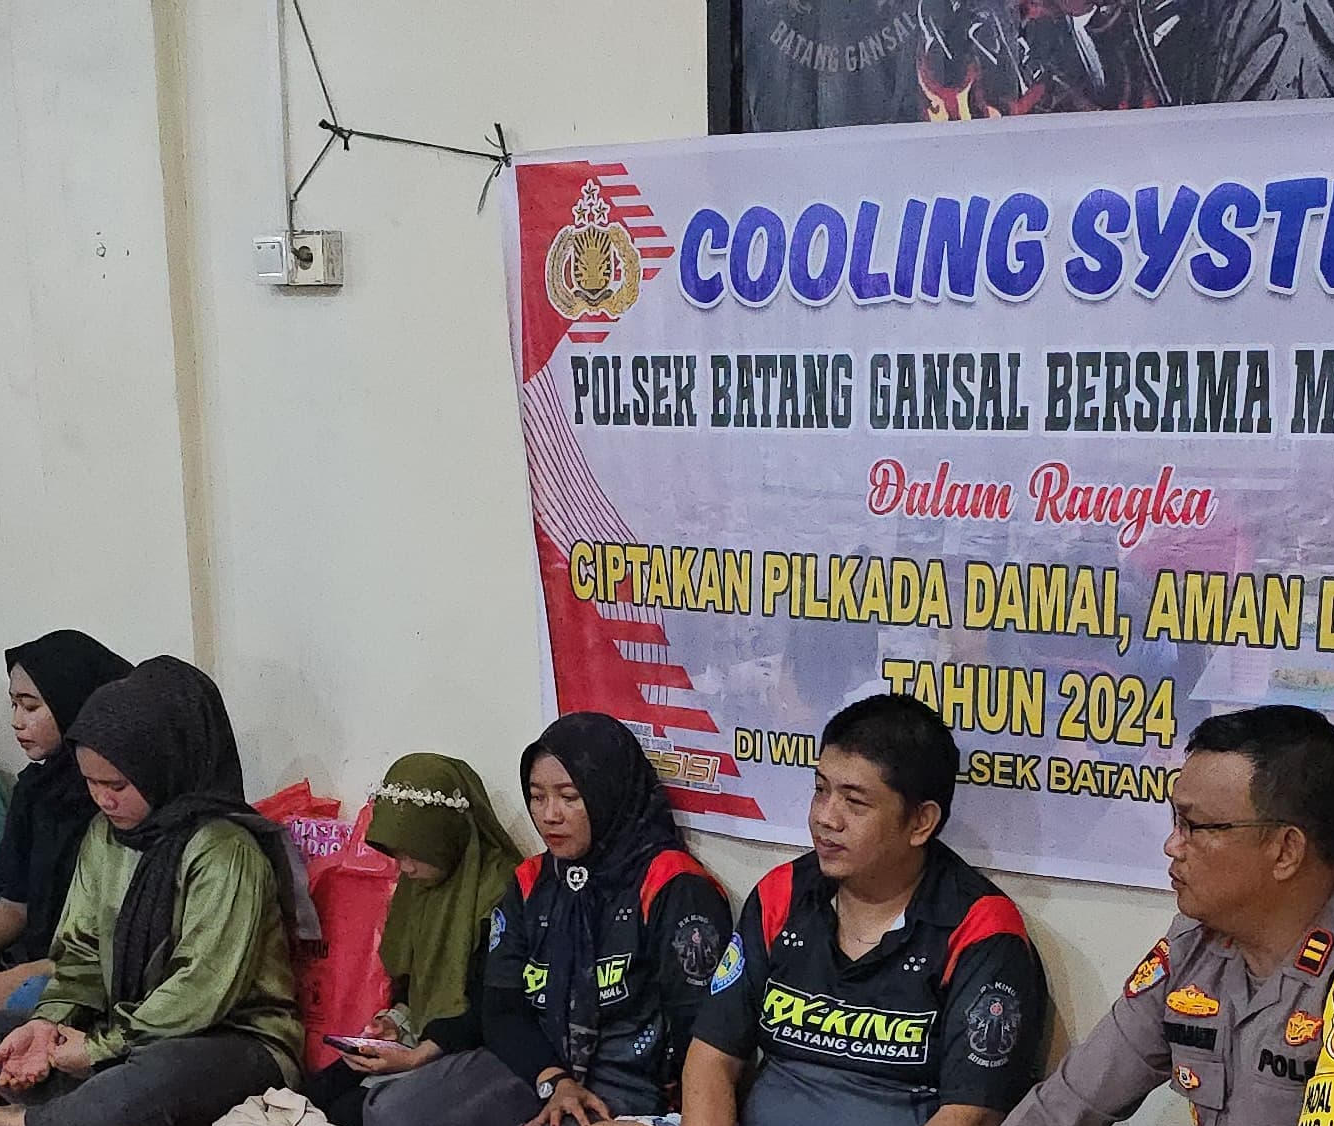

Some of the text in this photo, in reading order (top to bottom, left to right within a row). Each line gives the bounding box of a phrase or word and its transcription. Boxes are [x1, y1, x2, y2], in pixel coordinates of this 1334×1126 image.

[770, 19, 839, 72] BATANG
[679, 192, 1050, 304] COOLING
[570, 354, 697, 428] POLSEK
[709, 353, 853, 430] BATANG
[869, 351, 1030, 432] GANSAL
[1044, 348, 1272, 435] BERSAMA
[868, 459, 1216, 549] Dalam Rangka
[570, 540, 753, 614] CIPTAKAN
[762, 550, 953, 628] PILKADA
[964, 562, 1132, 654] DAMAI,
[1144, 570, 1305, 650] AMAN
[734, 727, 763, 763] DI
[882, 658, 1177, 748] TAHUN 2024
[763, 988, 929, 1043] RX-KING
[781, 1026, 920, 1059] BATANG GANSAL
